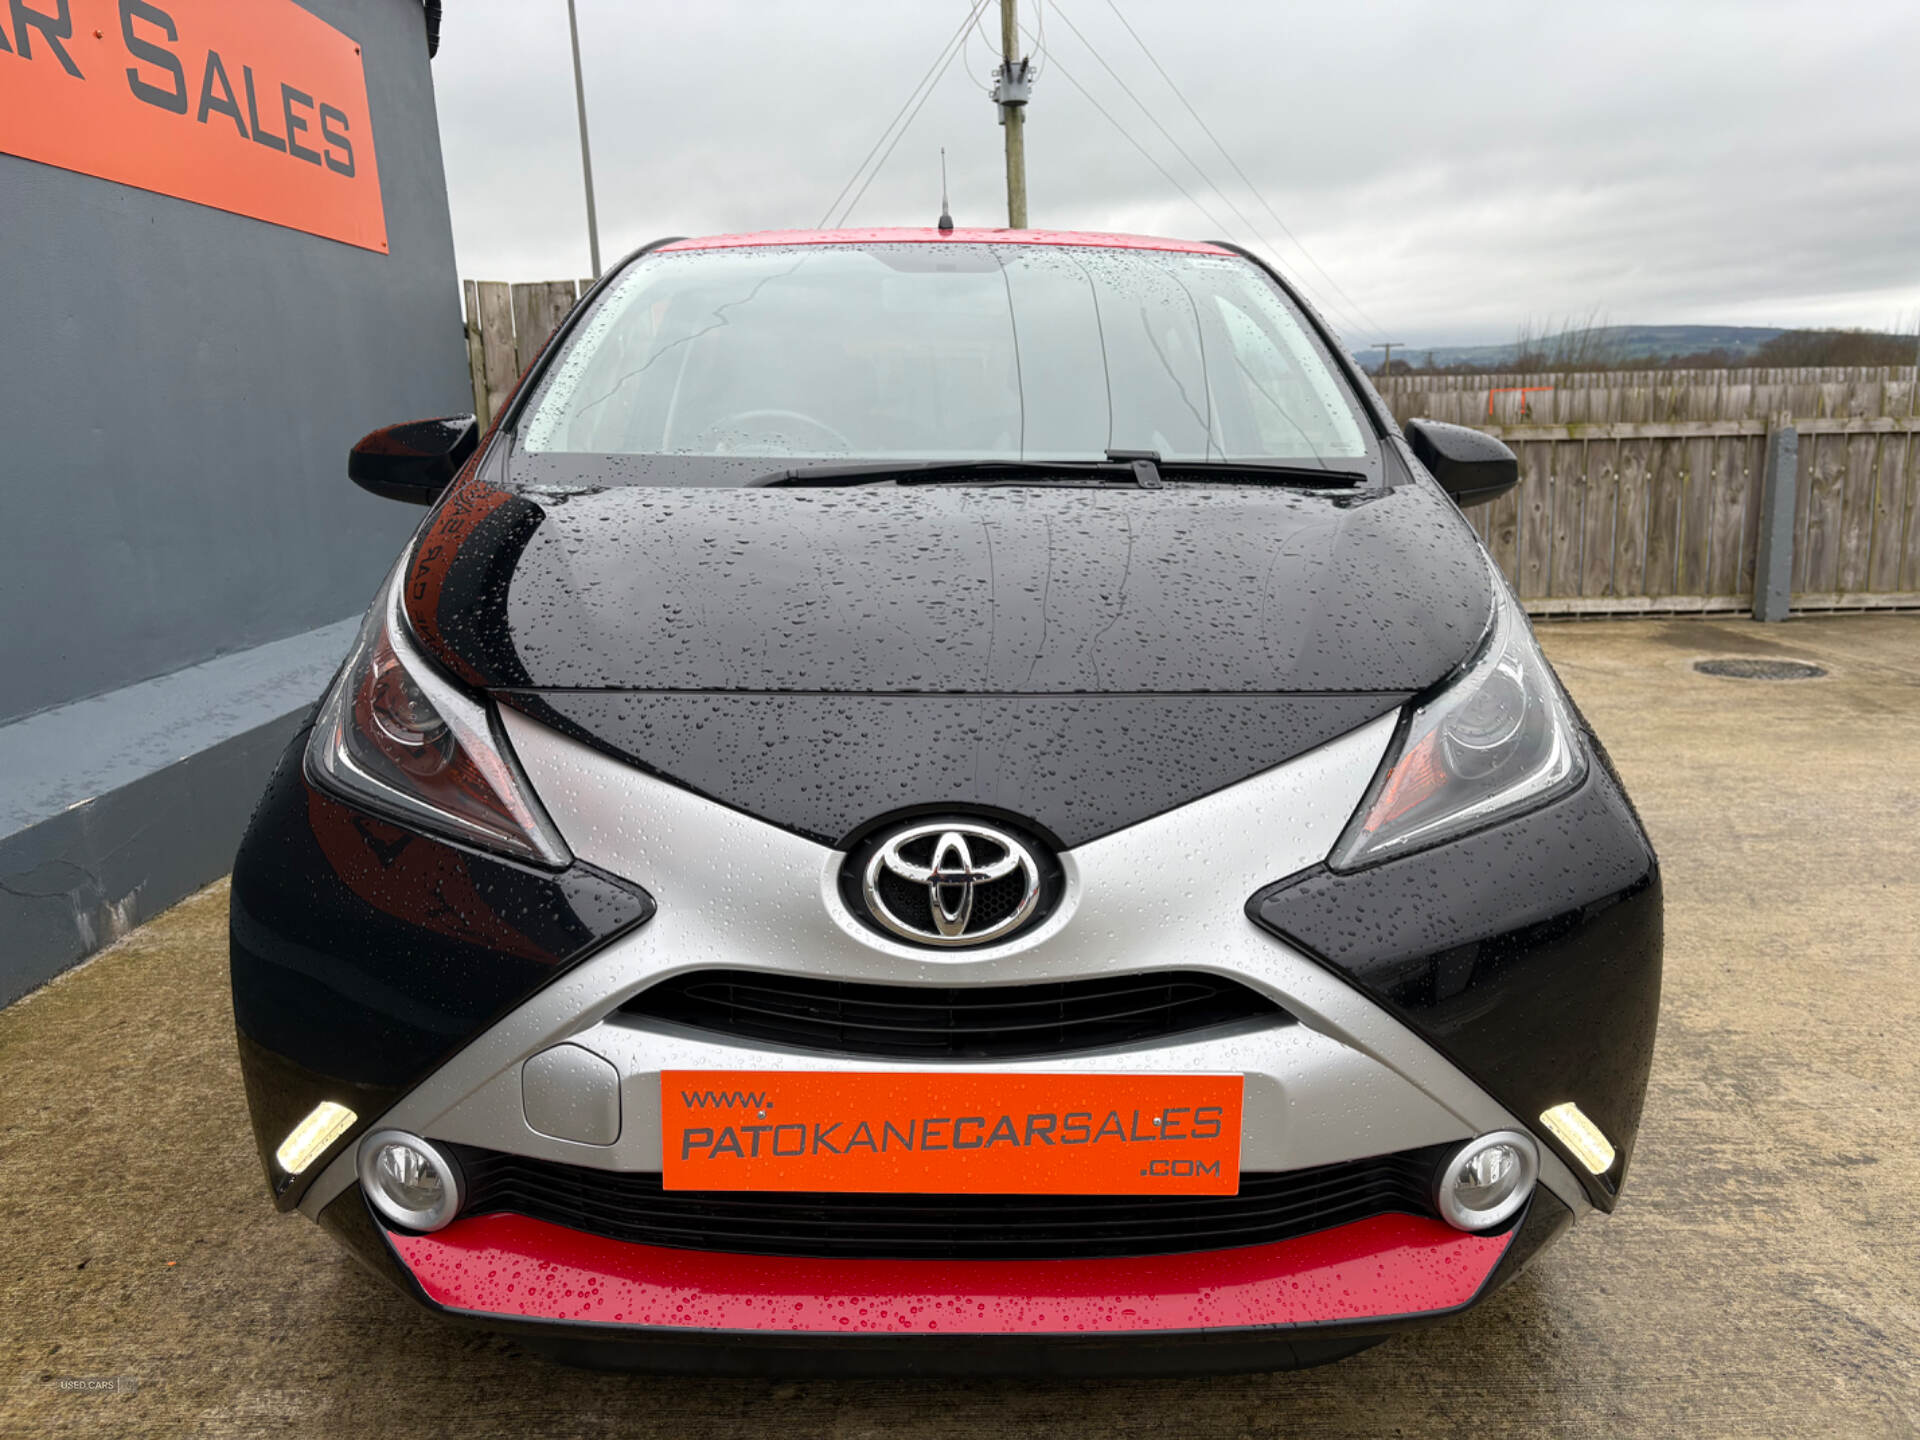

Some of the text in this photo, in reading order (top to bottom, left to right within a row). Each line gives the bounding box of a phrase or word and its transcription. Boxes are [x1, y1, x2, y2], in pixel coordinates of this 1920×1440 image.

[0, 0, 356, 178] R SALES
[681, 1106, 1223, 1161] PATOKANECARSALES
[1140, 1159, 1220, 1178] .COM
